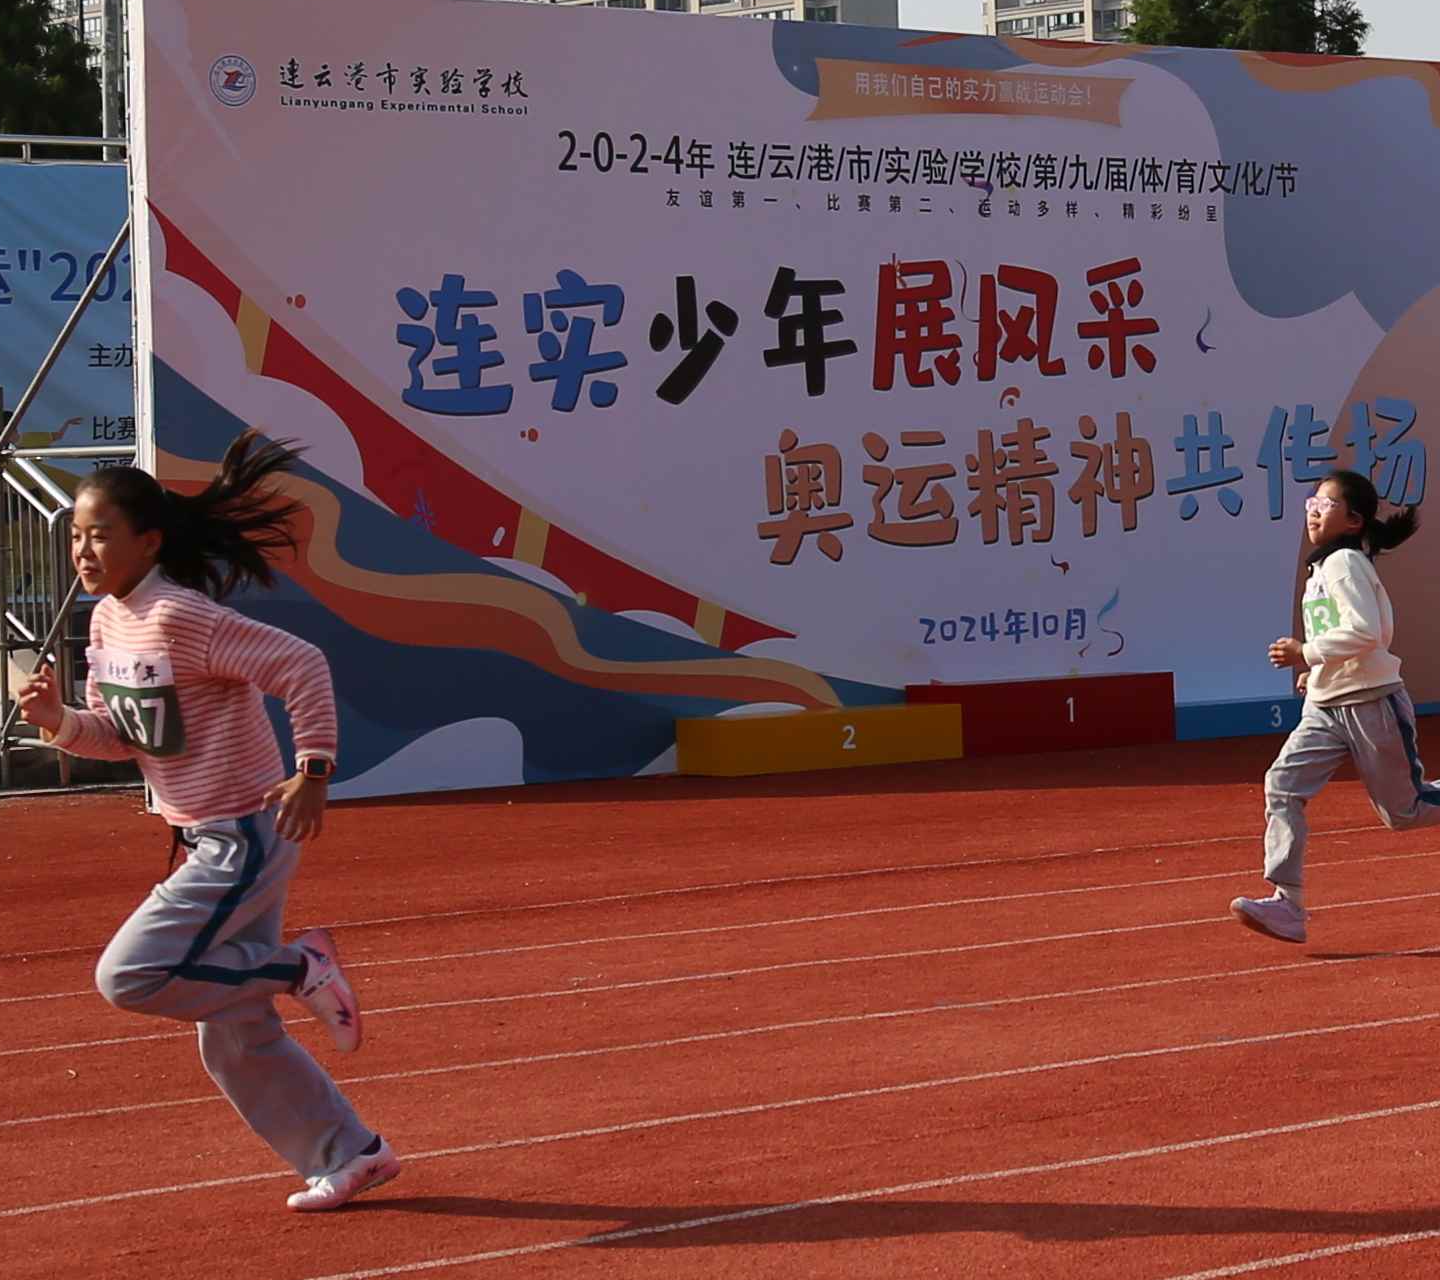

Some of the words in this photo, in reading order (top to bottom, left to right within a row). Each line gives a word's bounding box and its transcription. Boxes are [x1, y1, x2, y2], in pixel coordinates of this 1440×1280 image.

[280, 95, 375, 111] Lianyungang
[381, 99, 475, 114] Experimental
[481, 103, 529, 116] School
[395, 256, 1161, 417] 连实少年展风采
[919, 608, 1087, 645] 2024年10月
[1066, 696, 1076, 723] 1
[1270, 705, 1283, 729] 3
[841, 724, 857, 751] 2
